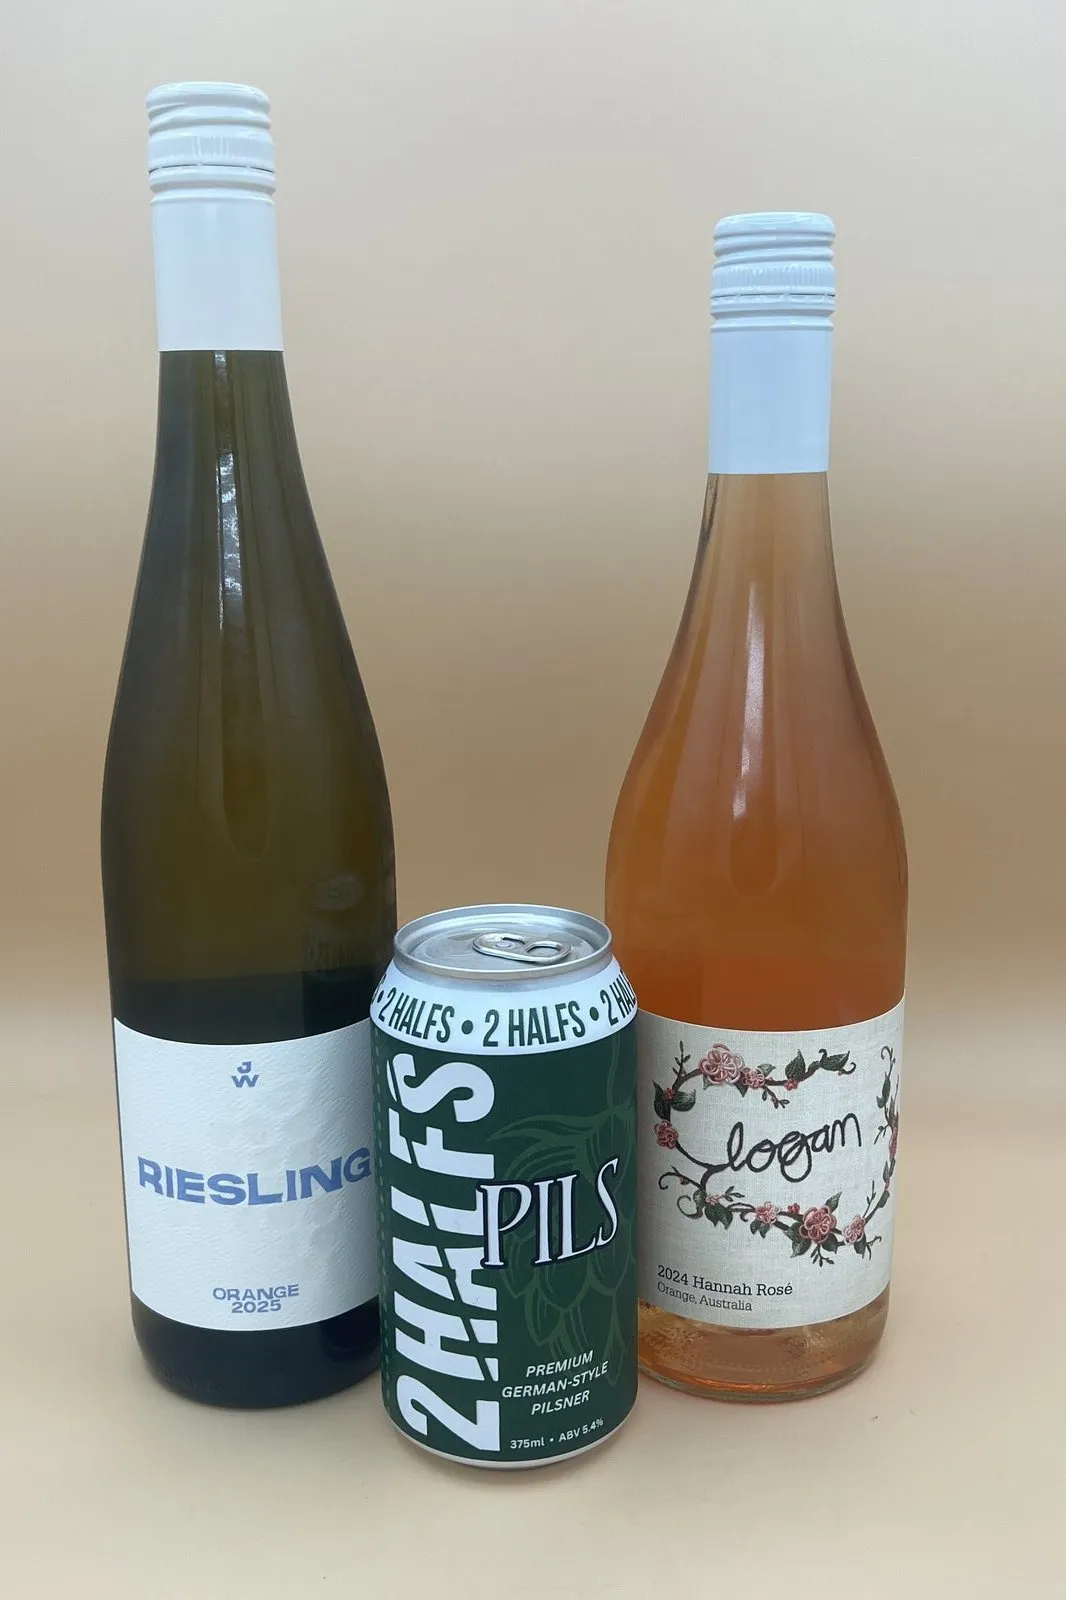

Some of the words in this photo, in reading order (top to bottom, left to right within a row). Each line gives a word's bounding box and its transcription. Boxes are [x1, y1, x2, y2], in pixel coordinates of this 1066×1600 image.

[378, 987, 397, 1022] 2
[388, 992, 455, 1043] HALFS
[599, 989, 619, 1026] 2
[609, 970, 637, 1018] HAL
[482, 1009, 500, 1047] 2
[508, 1000, 586, 1047] HALFS
[724, 1112, 863, 1183] logan
[137, 1146, 373, 1206] RIESLING
[475, 1158, 620, 1268] PILS
[212, 1284, 300, 1301] ORANGE
[657, 1264, 688, 1286] 2024
[693, 1275, 752, 1296] Hannah
[756, 1282, 793, 1296] Rosé
[657, 1281, 697, 1305] Orange,
[700, 1294, 753, 1312] Australia
[231, 1299, 282, 1314] 2025
[502, 1360, 609, 1398] GERMAN-STYLE
[526, 1350, 594, 1378] PREMIUM
[531, 1390, 590, 1416] PILSNER
[510, 1437, 545, 1449] 375ml
[559, 1427, 581, 1443] ABV
[582, 1418, 604, 1435] 5.4%
